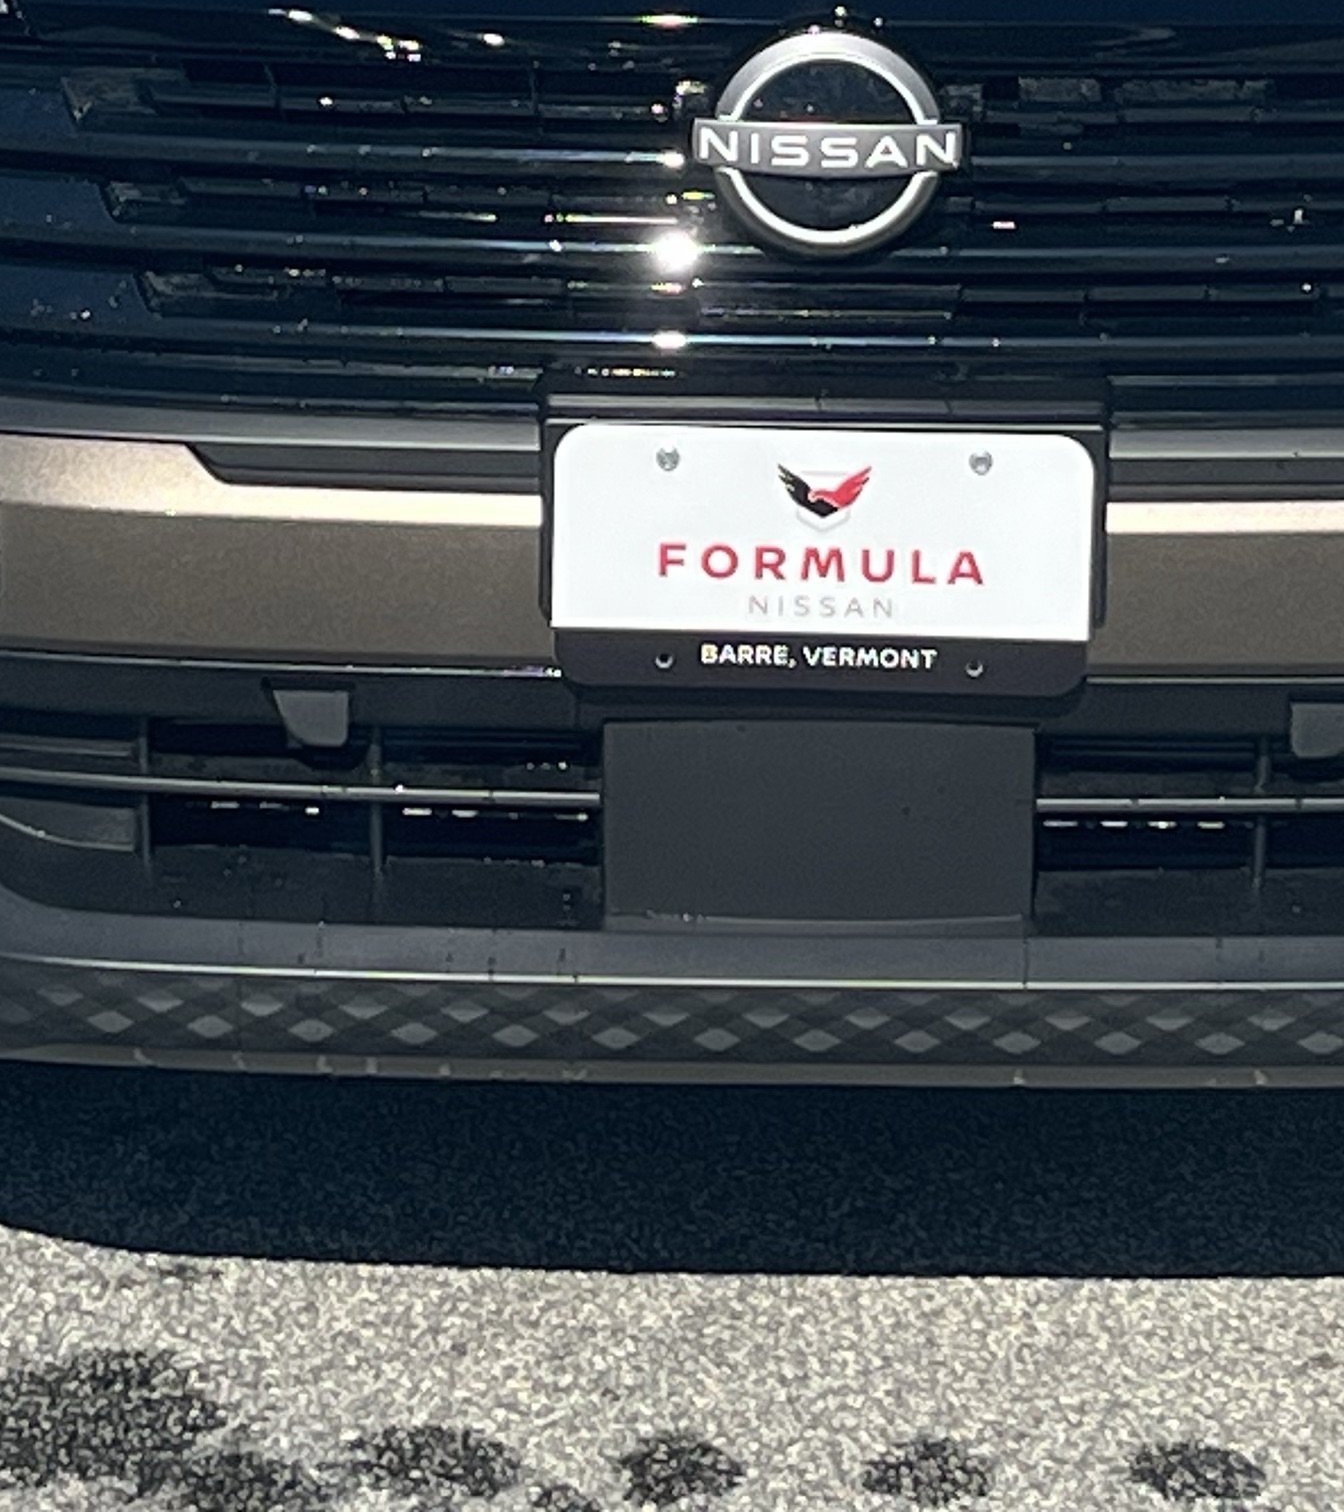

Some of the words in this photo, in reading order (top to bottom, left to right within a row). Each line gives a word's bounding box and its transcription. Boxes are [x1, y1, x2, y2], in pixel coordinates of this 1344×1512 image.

[698, 126, 958, 168] NISSAN
[658, 542, 985, 586] FORMULA
[748, 594, 894, 619] NISSAN
[700, 643, 797, 670] BARRE,
[803, 647, 938, 671] VERMONT
